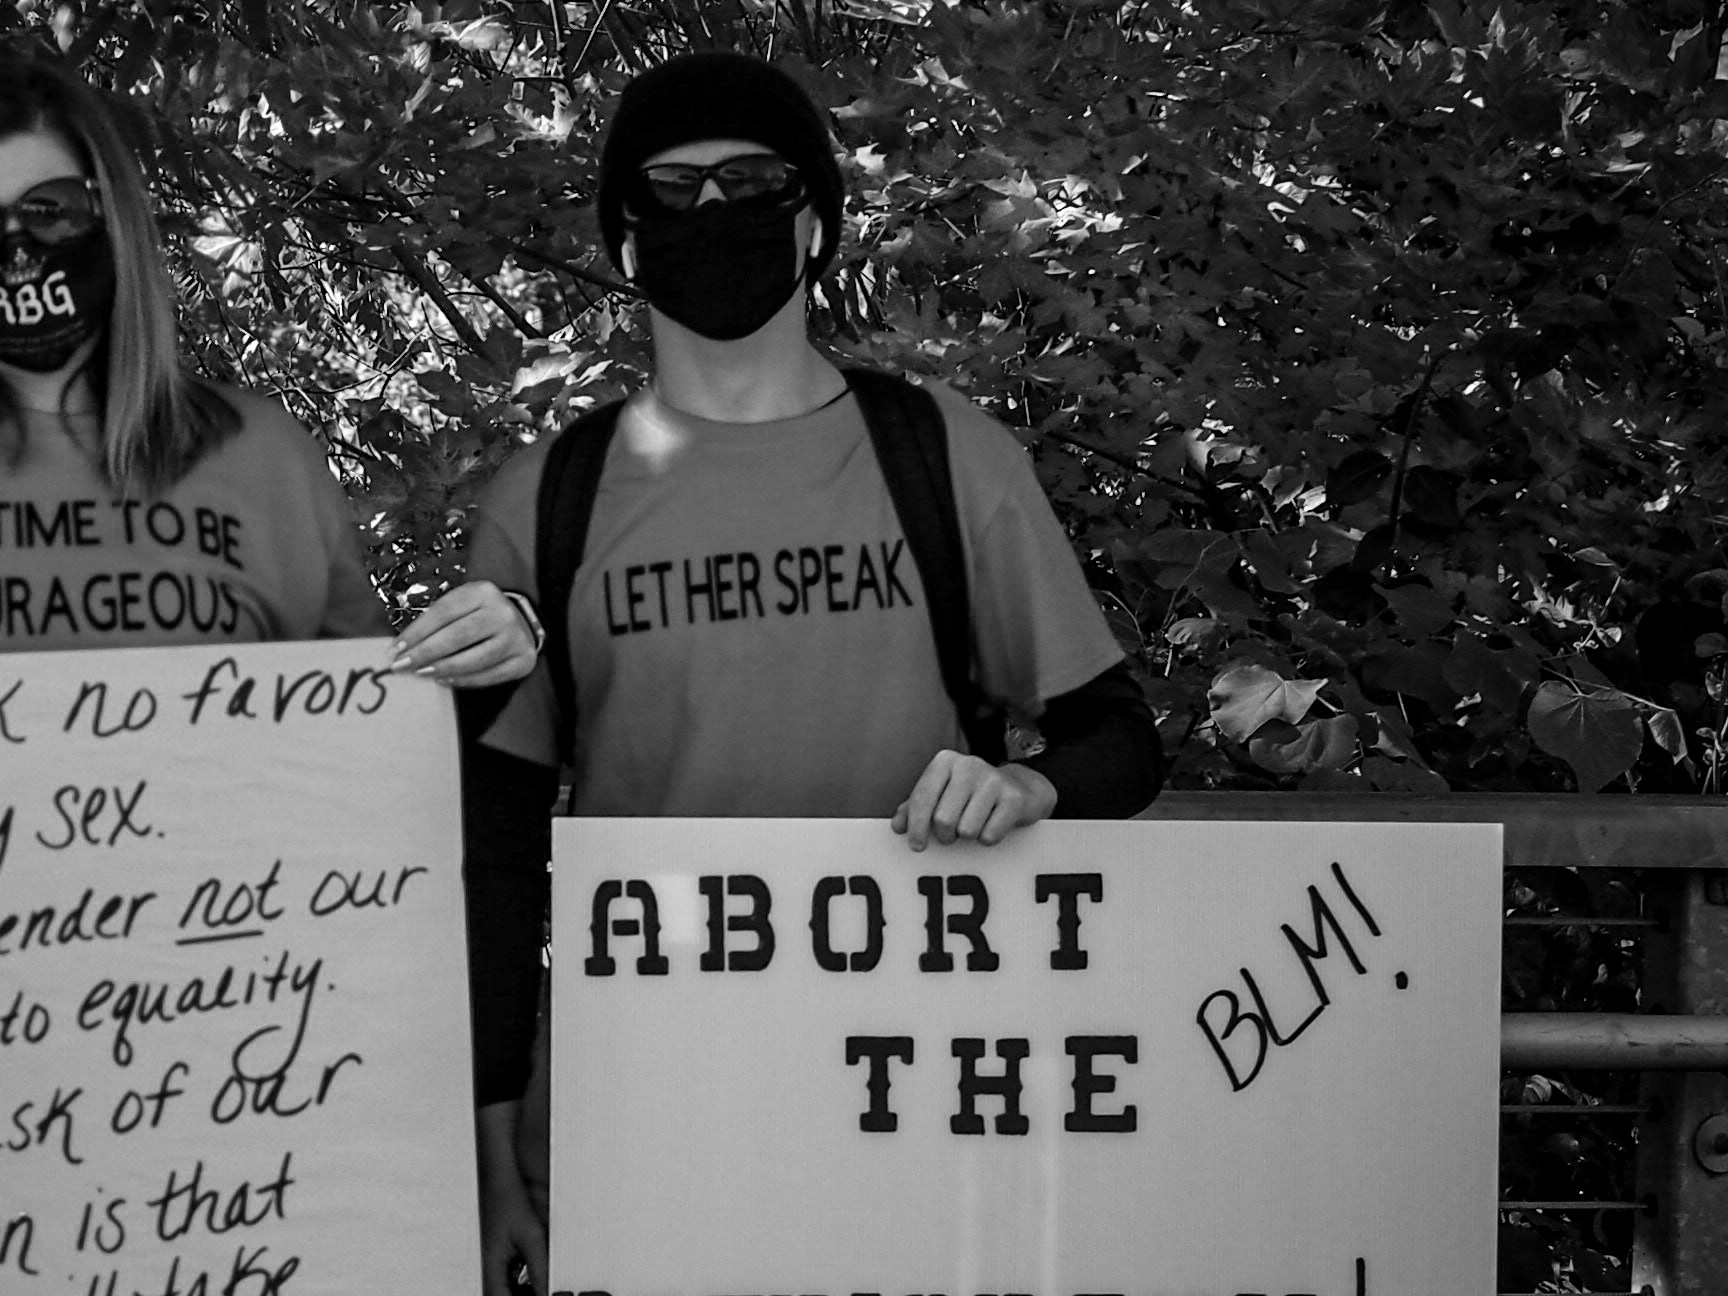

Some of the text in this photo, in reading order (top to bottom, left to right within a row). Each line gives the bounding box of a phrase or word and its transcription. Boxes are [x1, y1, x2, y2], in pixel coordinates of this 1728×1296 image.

[111, 499, 185, 546] TO
[195, 507, 244, 571] BE
[604, 538, 914, 636] LET HER SPEAK
[62, 681, 157, 739] no
[183, 657, 393, 726] favors
[177, 859, 286, 932] not
[309, 864, 429, 916] our
[583, 871, 1104, 978] ABORT
[0, 992, 47, 1045] to
[78, 950, 336, 1083] equality.
[1196, 860, 1410, 1094] BLM!
[110, 1062, 189, 1133] of
[212, 1053, 363, 1124] our
[845, 1035, 1139, 1137] THE
[76, 1188, 127, 1254] is
[146, 1152, 294, 1241] that
